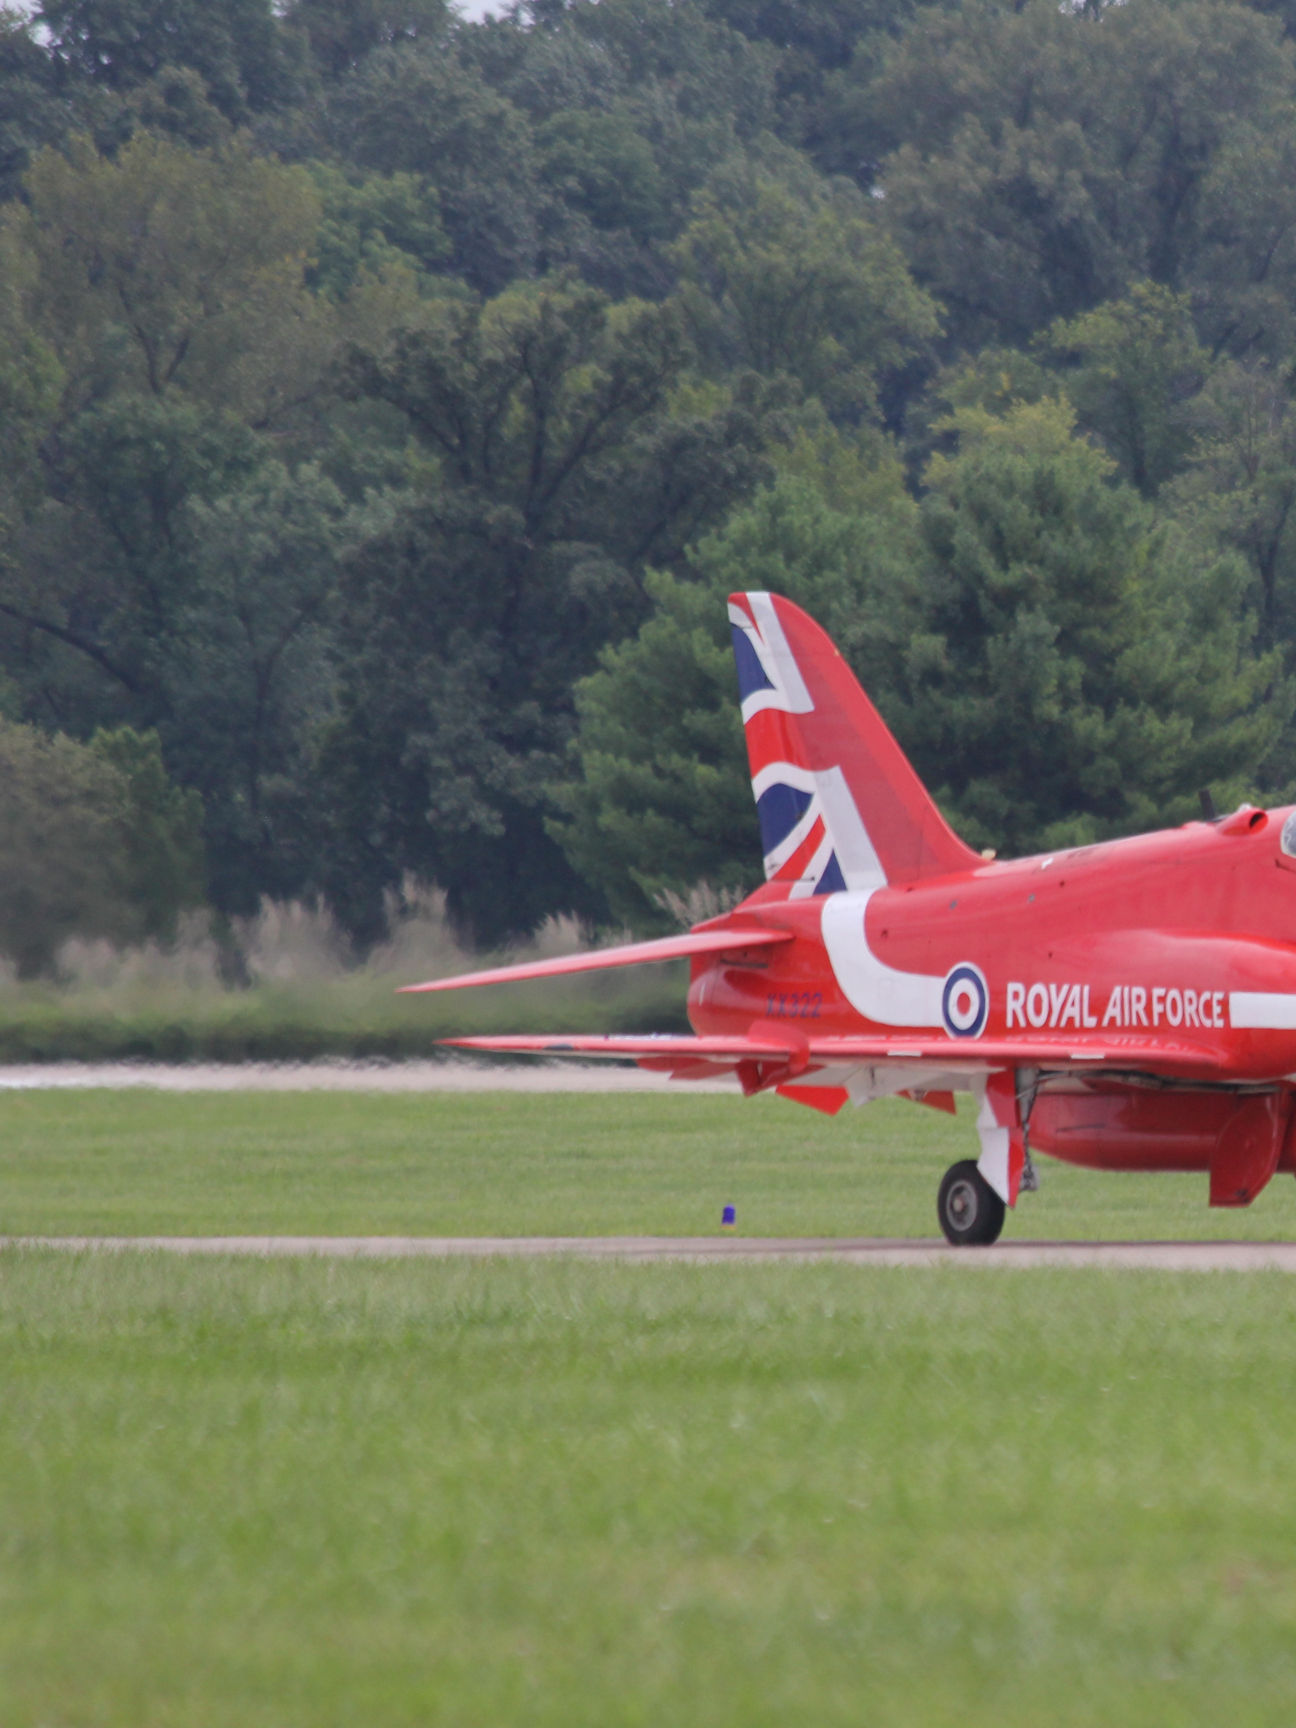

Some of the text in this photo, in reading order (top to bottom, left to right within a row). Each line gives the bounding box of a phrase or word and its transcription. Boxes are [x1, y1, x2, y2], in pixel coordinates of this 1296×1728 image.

[1005, 982, 1225, 1029] ROYAL AIR FORCE
